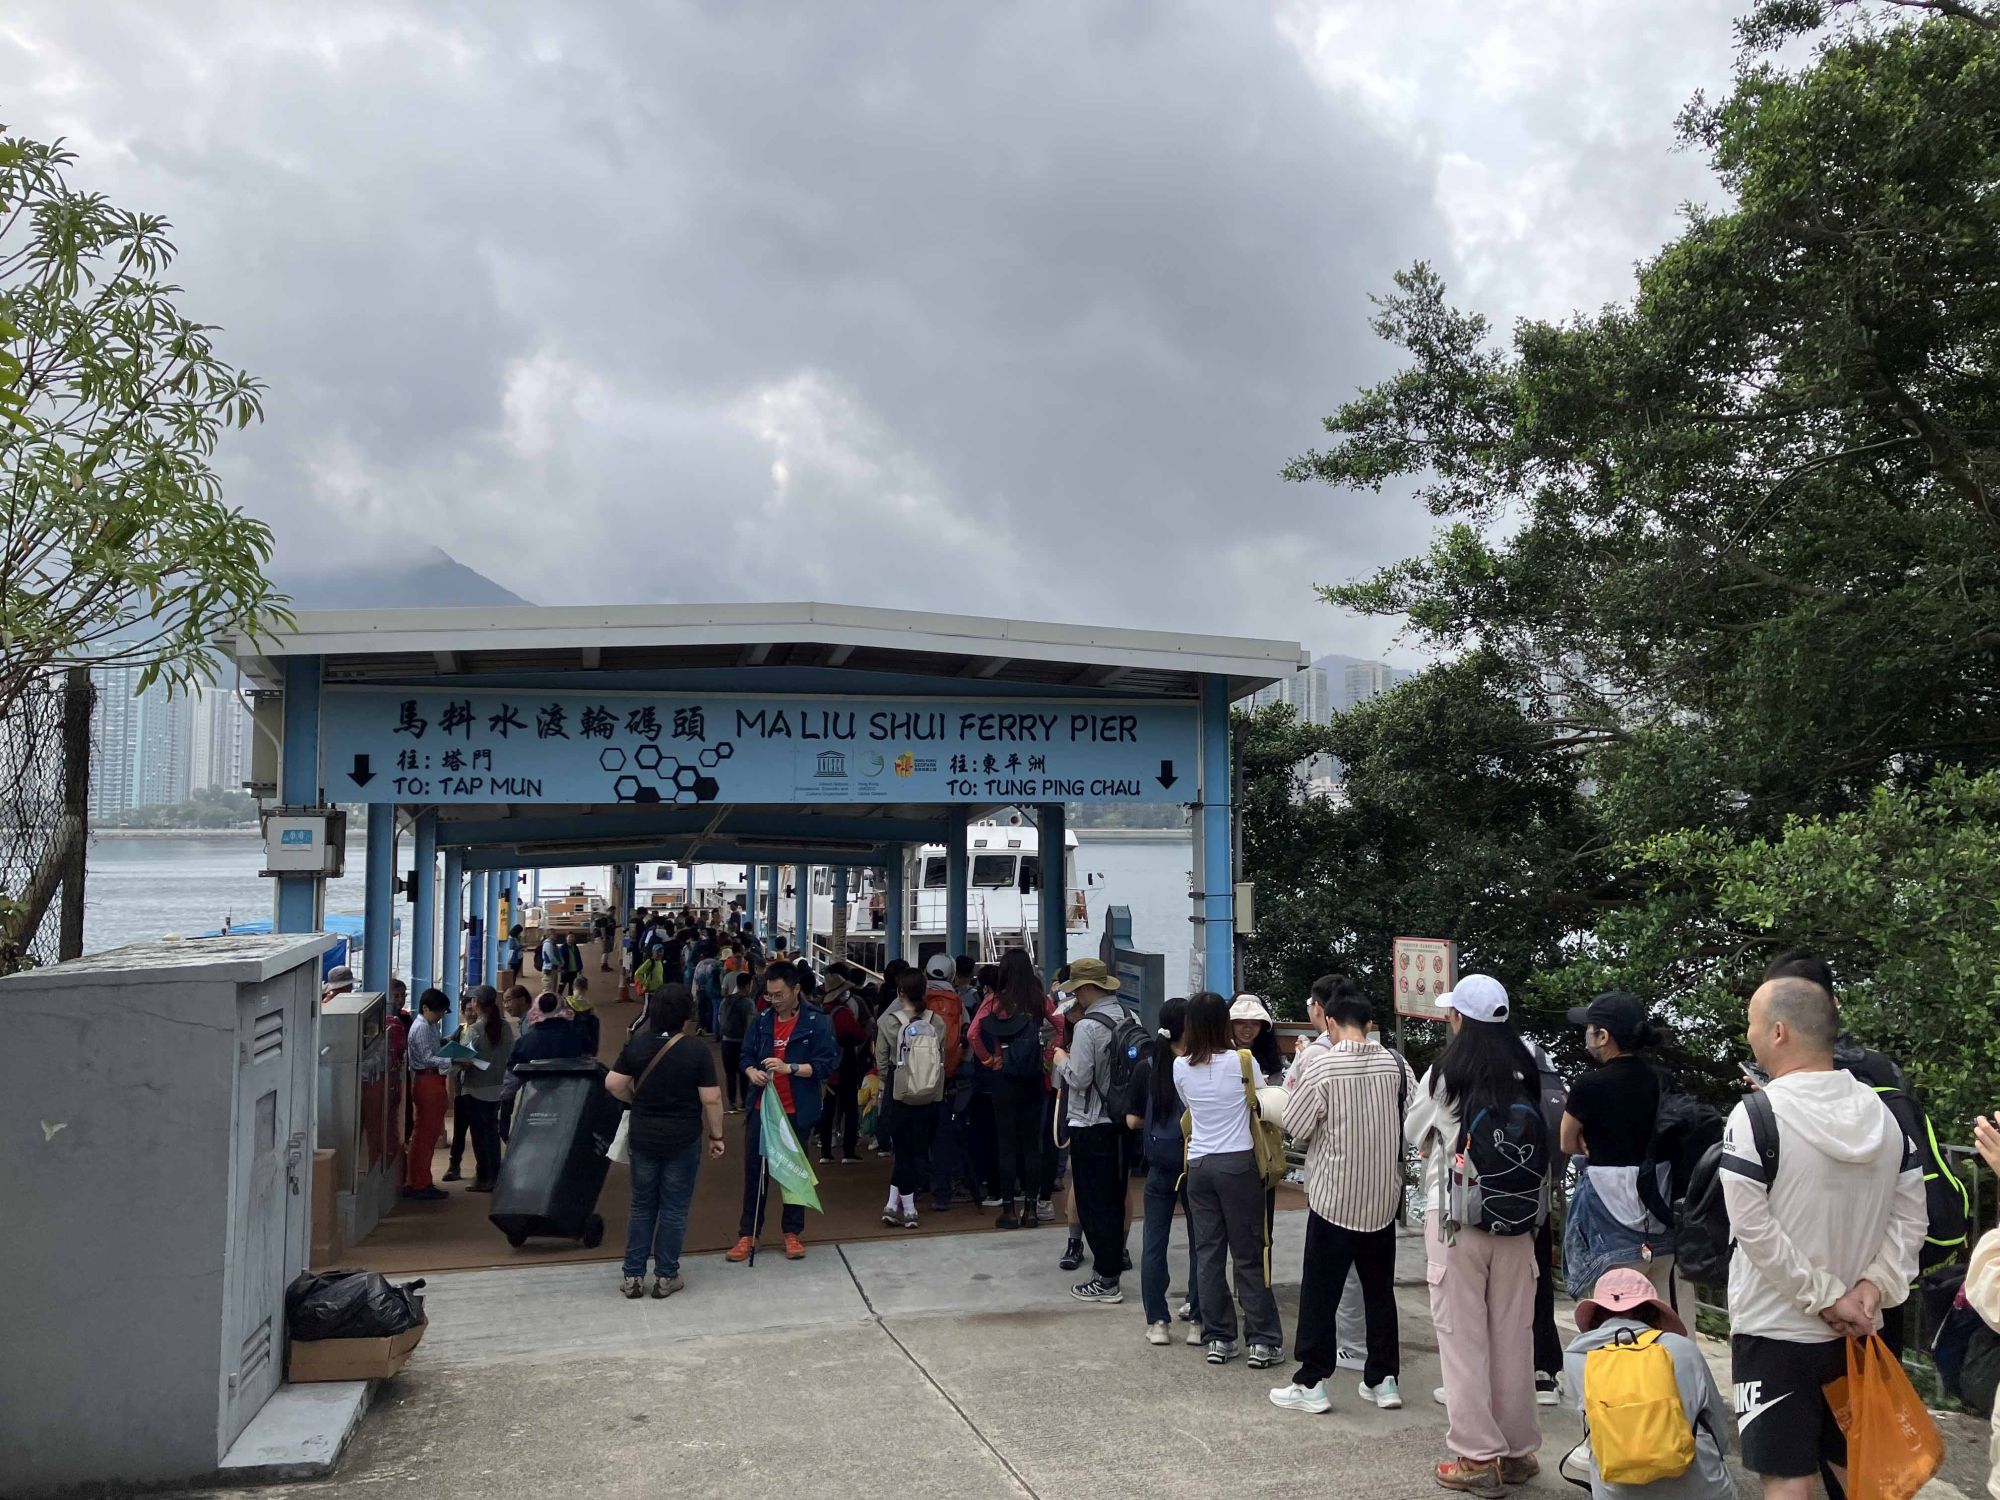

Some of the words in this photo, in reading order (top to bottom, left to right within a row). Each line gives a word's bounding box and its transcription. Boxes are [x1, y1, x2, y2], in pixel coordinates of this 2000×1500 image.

[392, 699, 706, 742] 馬料水渡輪碼頭
[735, 709, 792, 739] MA
[800, 710, 857, 740] LIU
[868, 711, 946, 741] SHUI
[958, 712, 1058, 742] FERRY
[1070, 713, 1138, 743] PIER
[392, 776, 430, 796] TO:
[438, 776, 484, 796] TAP
[490, 776, 543, 798] MUN
[945, 779, 978, 797] TO:
[984, 779, 1037, 797] TUNG
[1042, 779, 1085, 797] PING
[1090, 779, 1142, 798] CHAU
[1733, 1380, 1762, 1414] IKE
